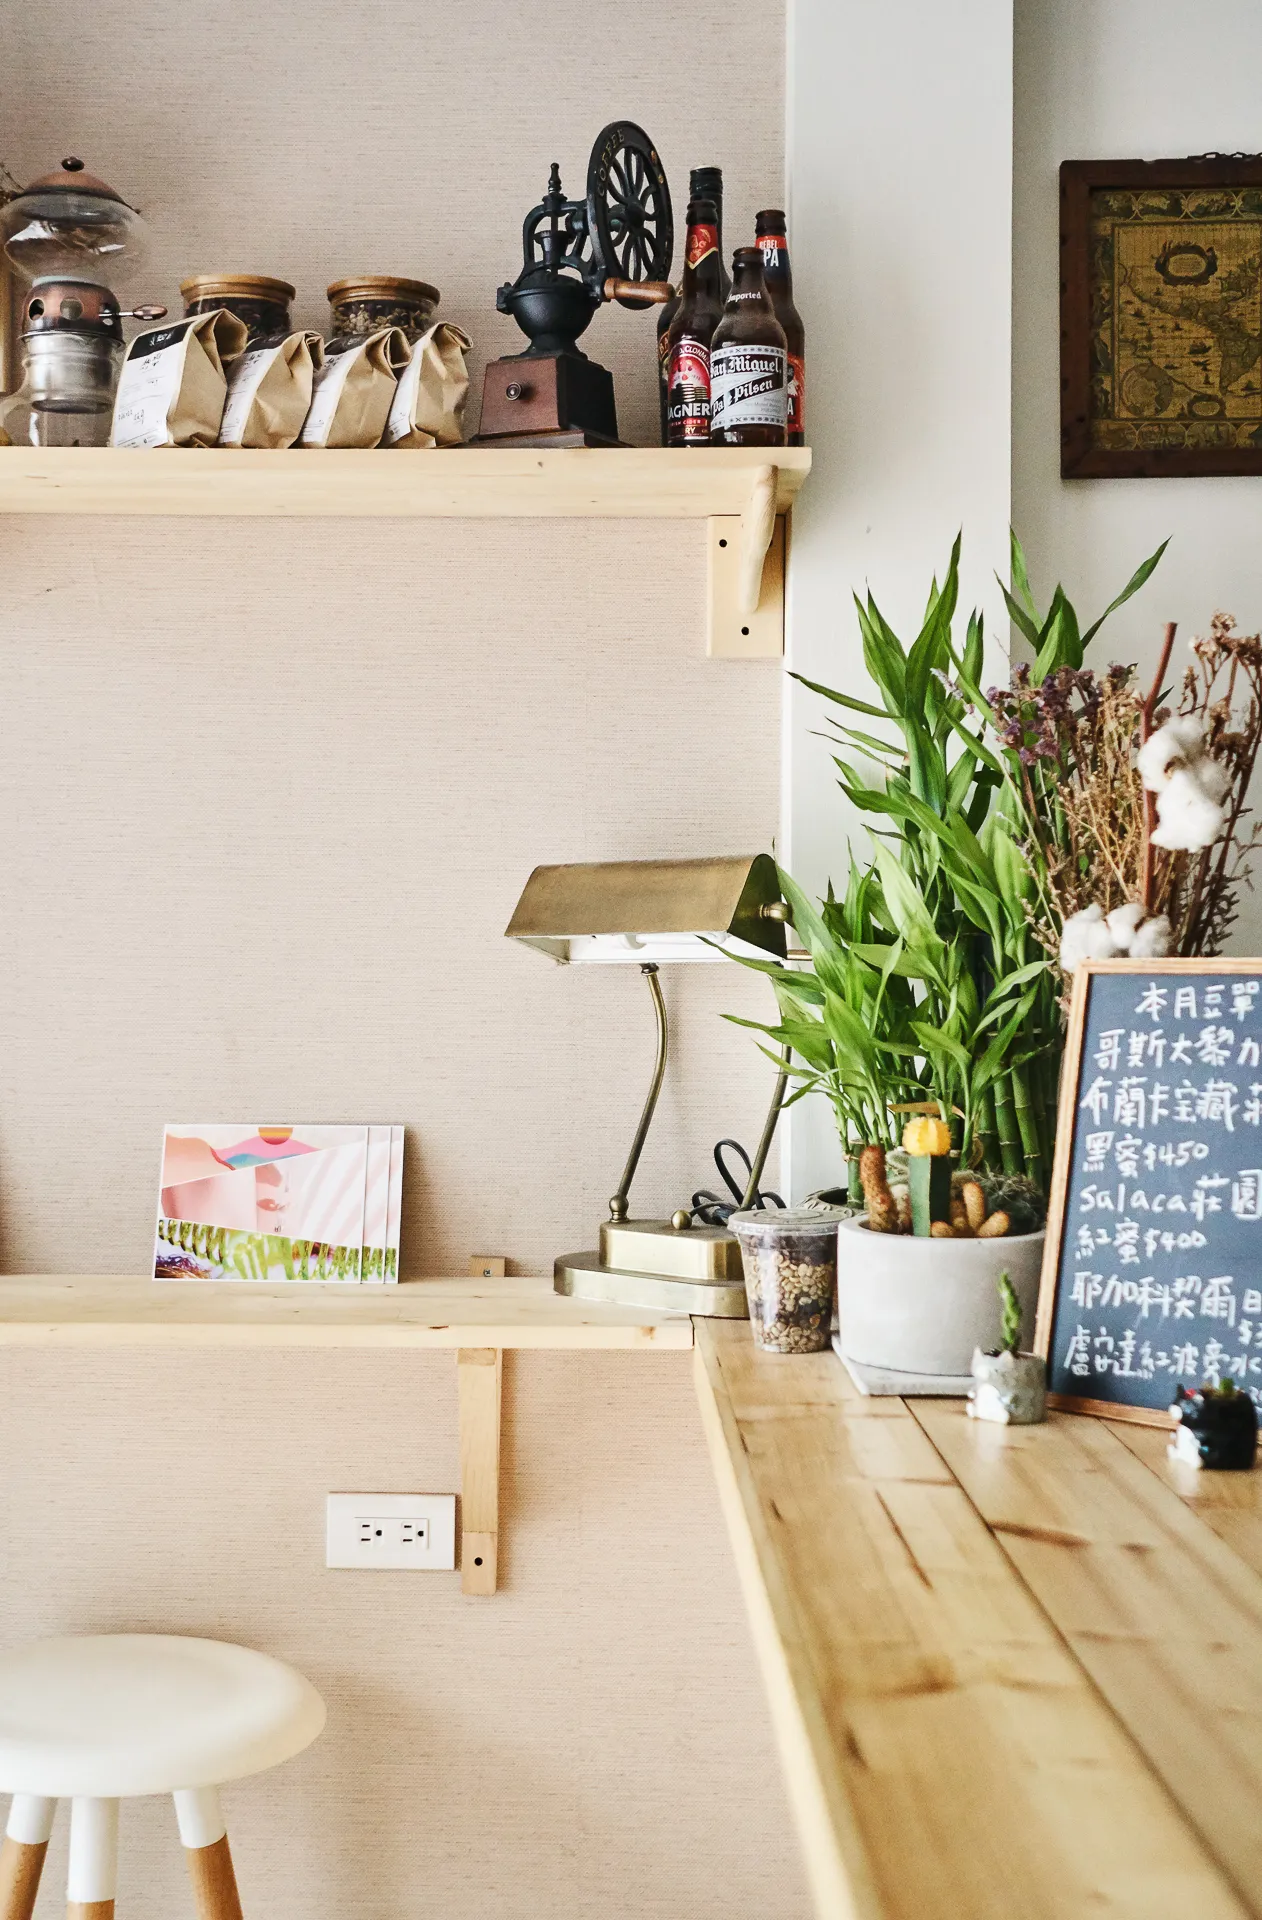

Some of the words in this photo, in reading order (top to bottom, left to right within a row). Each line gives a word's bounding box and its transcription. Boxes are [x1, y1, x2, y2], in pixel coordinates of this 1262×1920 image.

[597, 128, 625, 197] COFFEE
[763, 248, 779, 267] PA
[728, 355, 779, 375] Miguel
[733, 379, 773, 404] Pilsen
[668, 402, 711, 420] AGNER
[1134, 981, 1261, 1022] 本月豆單
